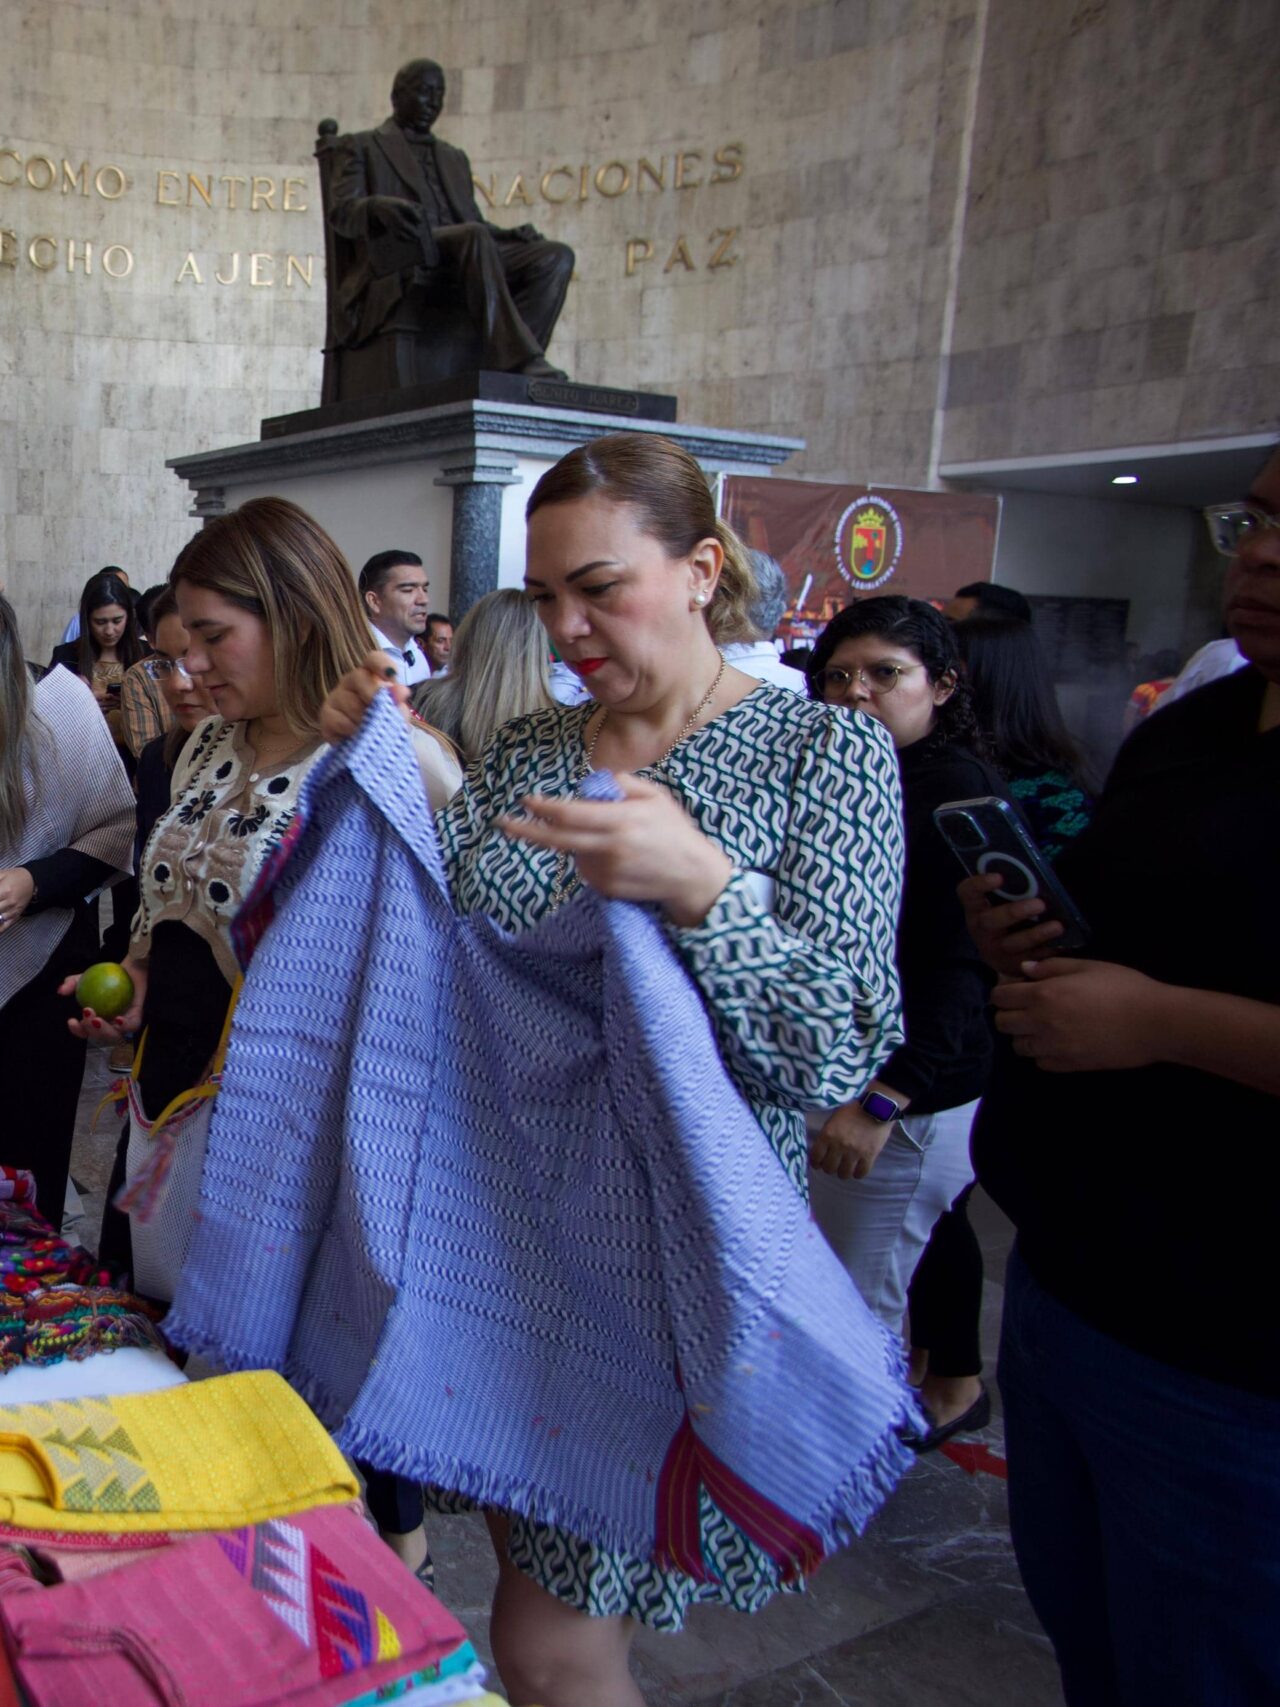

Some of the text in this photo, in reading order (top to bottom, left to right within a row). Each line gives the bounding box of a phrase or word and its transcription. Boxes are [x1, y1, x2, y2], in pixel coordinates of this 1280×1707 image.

[157, 169, 309, 213] ENTRE
[472, 143, 744, 208] NACIONES
[176, 251, 314, 290] AJEN
[624, 226, 741, 277] PAZ
